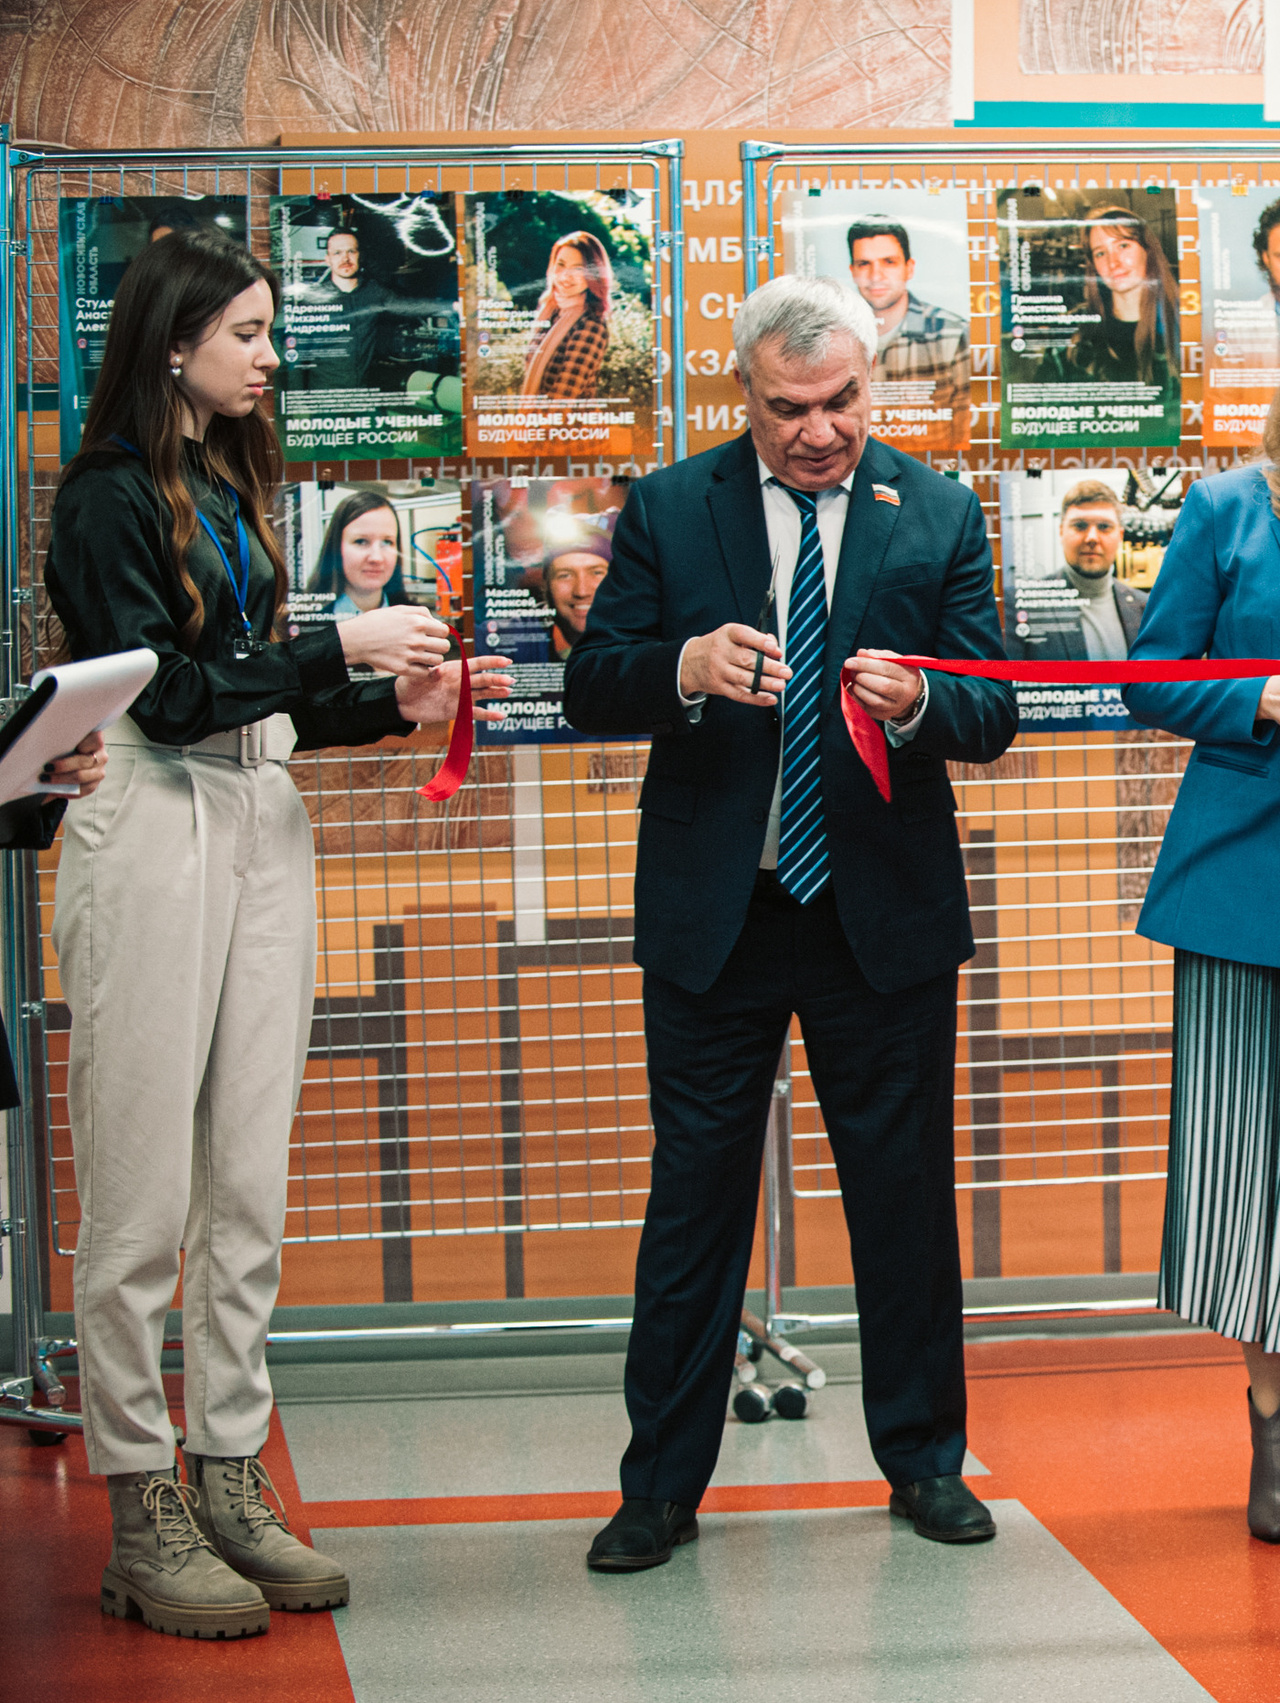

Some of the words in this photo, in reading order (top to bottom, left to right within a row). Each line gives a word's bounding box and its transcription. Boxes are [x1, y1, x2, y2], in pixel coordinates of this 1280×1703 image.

[683, 182, 743, 209] ДЛЯ
[88, 246, 98, 295] ОБЛАСТЬ
[76, 298, 115, 311] Студе
[1011, 295, 1064, 306] Гришина
[285, 304, 343, 314] Ядренкин
[478, 310, 541, 320] Екатерина
[1011, 305, 1068, 315] Кристина
[285, 313, 330, 323] Михаил
[478, 319, 551, 329] Михайловна
[1011, 314, 1102, 325] Александровна
[285, 324, 350, 335] Андреевич
[885, 408, 953, 422] УЧЕНЫЕ
[1012, 406, 1094, 420] МОЛОДЫЕ
[1097, 405, 1164, 418] УЧЕНЫЕ
[1214, 404, 1271, 418] МОЛОД
[287, 416, 371, 431] МОЛОДЫЕ
[375, 414, 443, 428] УЧЕНЫЕ
[478, 413, 563, 427] МОЛОДЫЕ
[566, 411, 635, 425] УЧЕНЫЕ
[869, 424, 928, 437] РОССИИ
[1012, 421, 1077, 436] БУДУЩЕЕ
[1080, 420, 1139, 434] РОССИИ
[286, 432, 354, 447] БУДУЩЕЕ
[357, 430, 418, 444] РОССИИ
[478, 428, 546, 443] БУДУЩЕЕ
[549, 427, 610, 441] РОССИИ
[288, 592, 337, 604] Брагина
[486, 588, 530, 598] Маслов
[288, 602, 323, 612] Ольга
[486, 597, 536, 608] Алексей
[486, 607, 557, 618] Алексеевич
[1016, 690, 1100, 705] МОЛОДЫЕ
[487, 701, 563, 716] МОЛОДЫ
[1018, 704, 1083, 720] БУДУЩЕЕ
[487, 716, 555, 732] БУДУЩЕЕ
